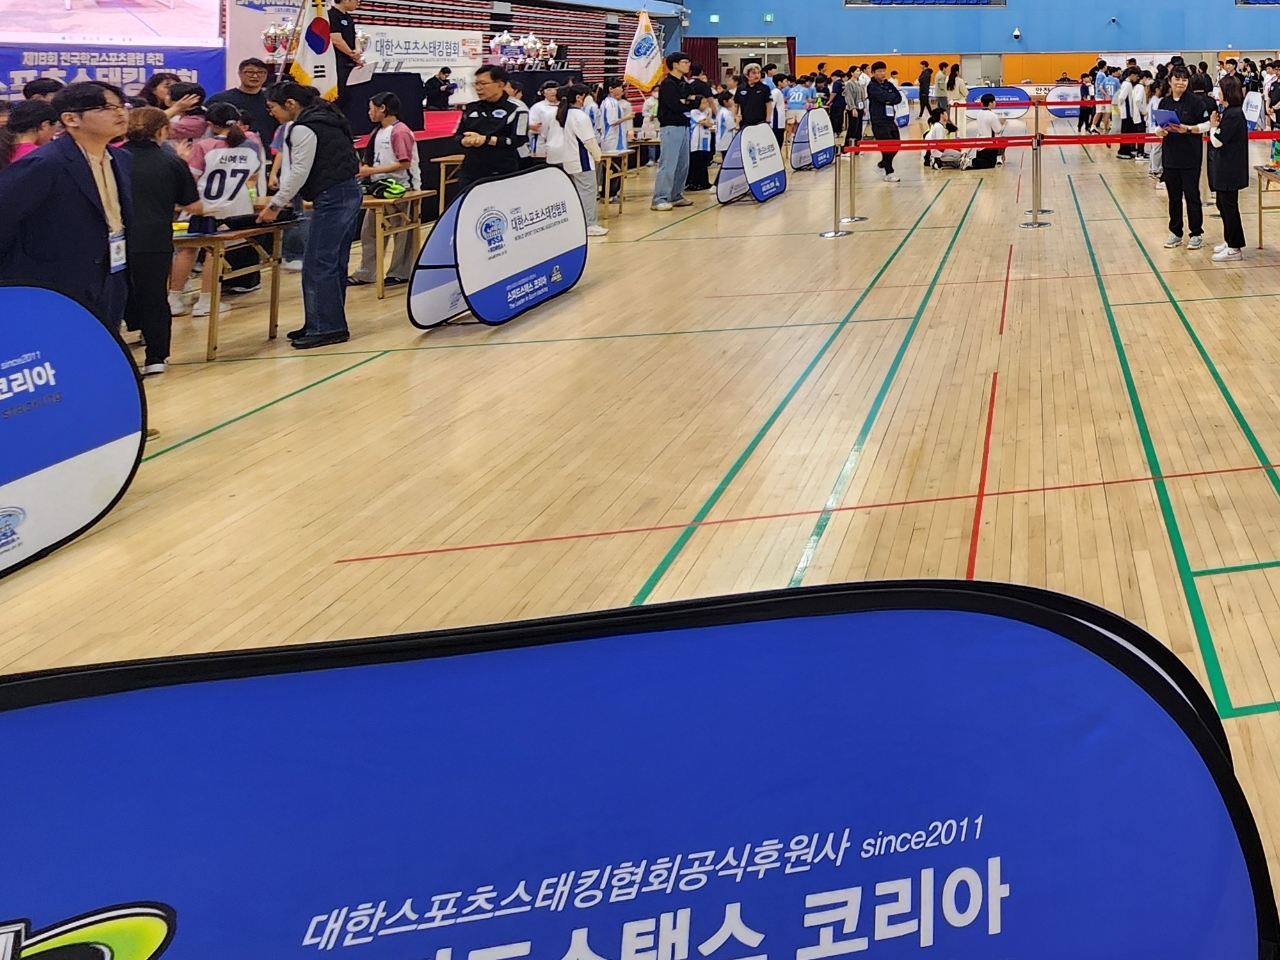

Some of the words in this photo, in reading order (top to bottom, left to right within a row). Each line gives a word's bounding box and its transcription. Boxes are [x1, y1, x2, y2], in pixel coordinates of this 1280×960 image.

[22, 51, 58, 66] 제18회
[375, 39, 460, 57] 대한스포츠스태킹협회
[0, 67, 146, 101] 포츠스태킹
[204, 168, 250, 201] 07
[511, 200, 567, 231] 대한스포츠스태킹협회
[2, 392, 62, 419] stacking
[301, 827, 852, 952] 대한스포츠스태킹협회공식후원사
[860, 814, 984, 859] since2011
[795, 856, 1010, 960] 코리아
